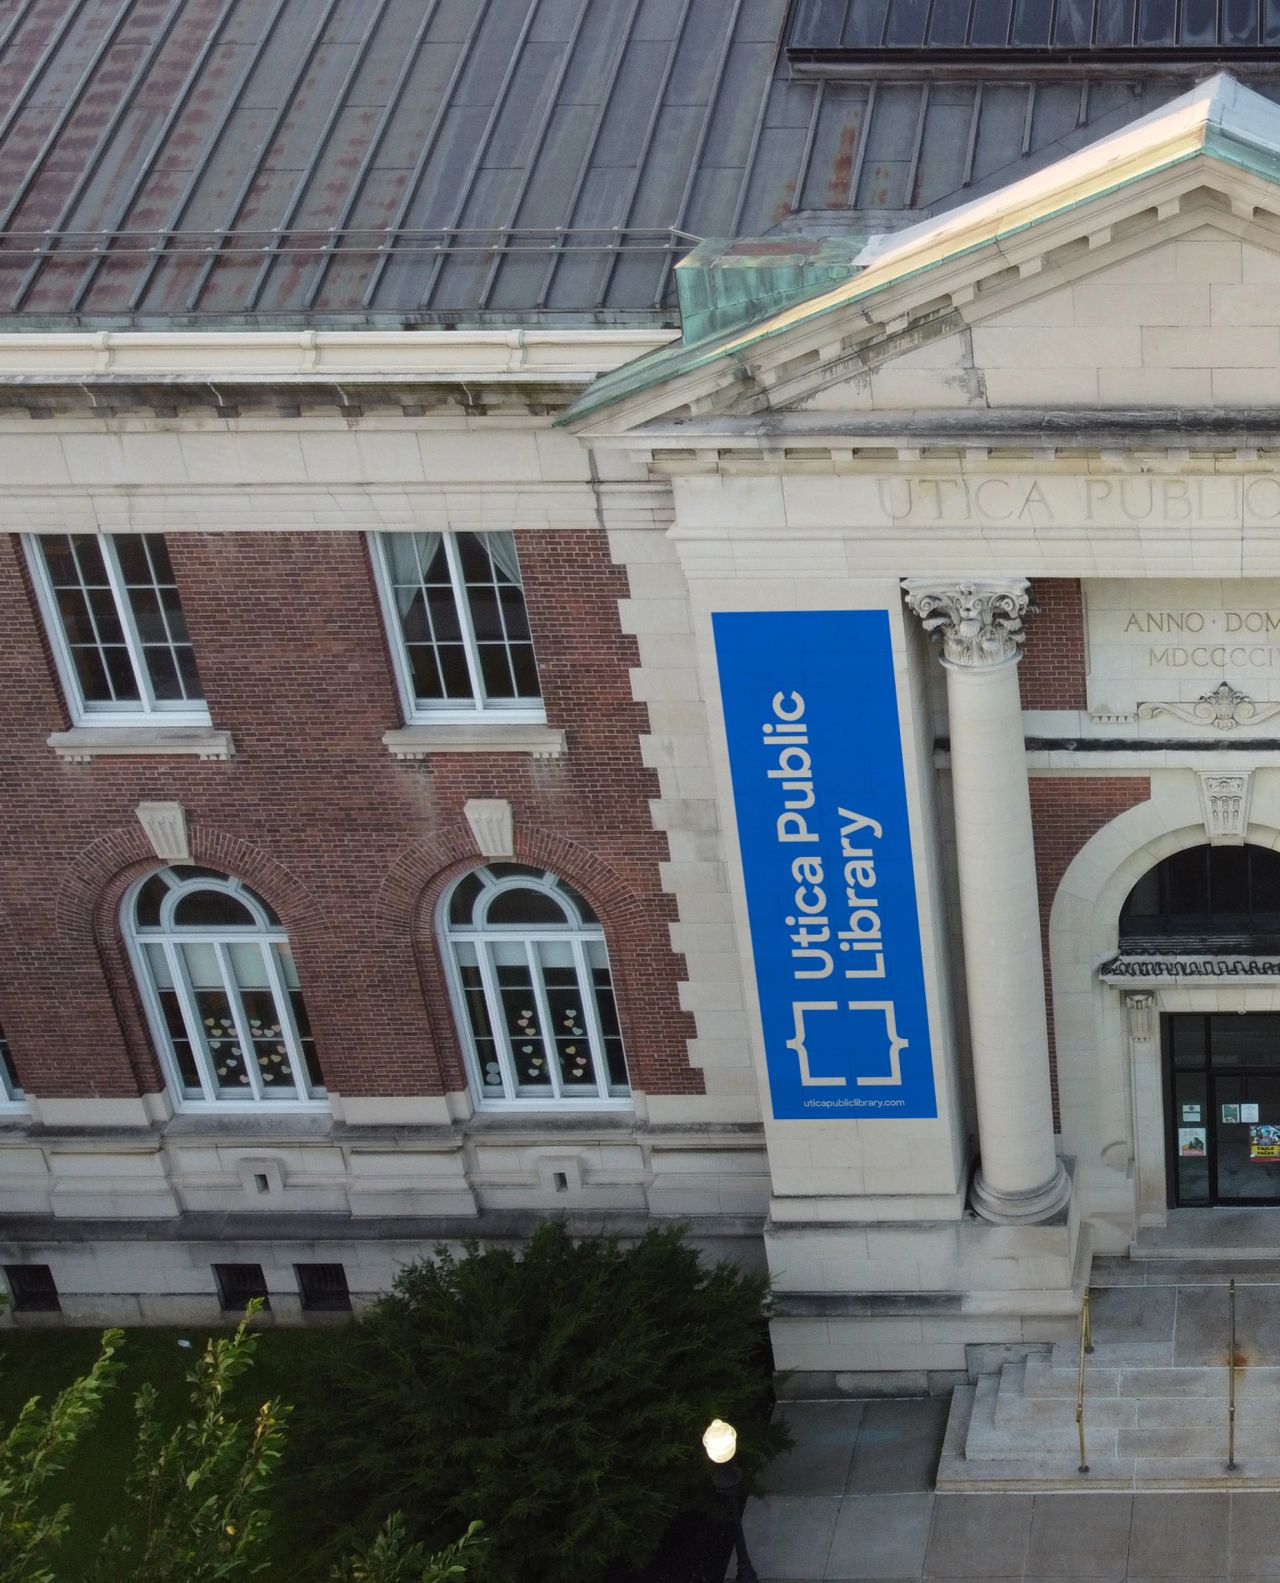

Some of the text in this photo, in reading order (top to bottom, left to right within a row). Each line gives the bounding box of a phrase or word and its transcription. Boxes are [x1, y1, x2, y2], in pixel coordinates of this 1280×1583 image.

[875, 478, 1055, 520] UTICA
[1083, 477, 1280, 520] PUBLIC
[1124, 612, 1204, 633] ANNO
[762, 690, 834, 980] Utica Public
[837, 806, 886, 979] Library
[803, 1098, 906, 1109] uticapubliclibrary.com
